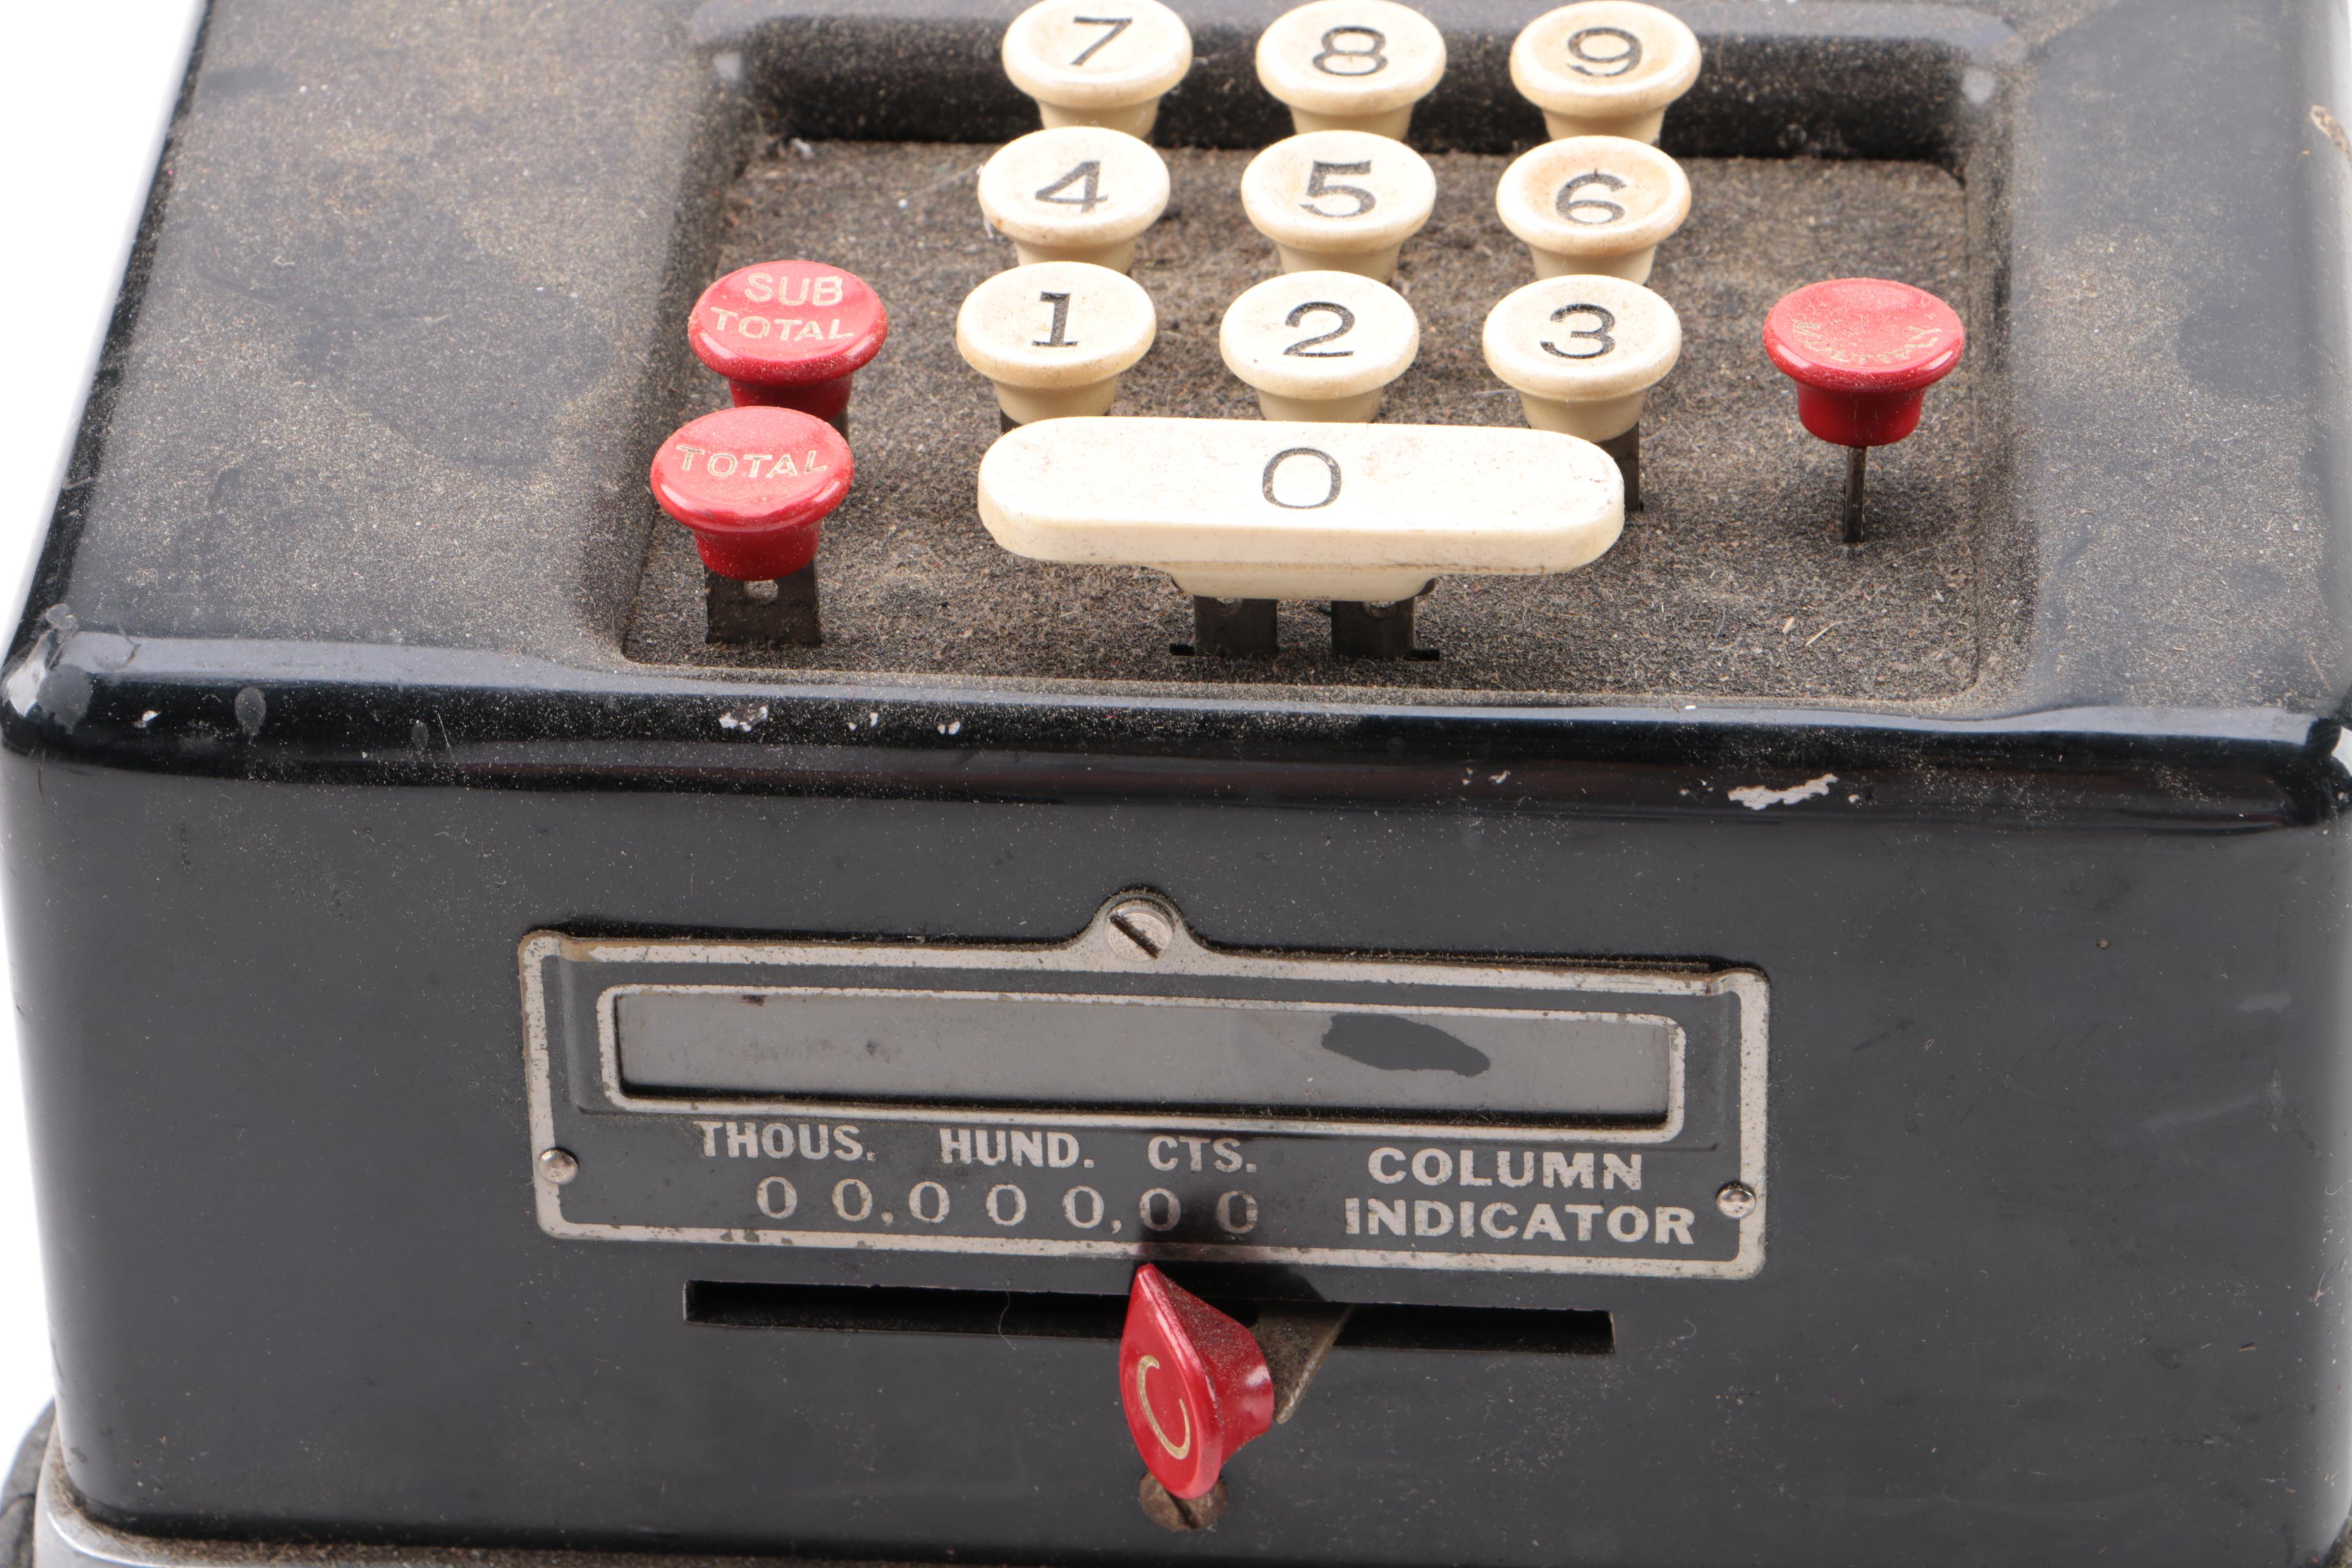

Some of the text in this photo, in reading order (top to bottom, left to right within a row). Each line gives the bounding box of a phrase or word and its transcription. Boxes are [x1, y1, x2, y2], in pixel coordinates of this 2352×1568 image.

[1072, 15, 1133, 67] 7
[1312, 25, 1389, 77] 8
[1566, 26, 1643, 78] 9
[1034, 160, 1110, 214] 4
[1298, 159, 1377, 219] 5
[1554, 172, 1627, 226] 6
[744, 272, 844, 306] SUB
[710, 307, 855, 342] TOTAL
[1031, 291, 1079, 348] 1
[1282, 301, 1356, 358] 2
[1539, 303, 1617, 360] 3
[675, 445, 828, 479] TOTAL
[692, 1121, 1257, 1174] THOUS. HUND. CTS.
[1367, 1146, 1643, 1191] COLUMN
[1345, 1198, 1696, 1246] INDICATOR
[1137, 1354, 1191, 1460] C
